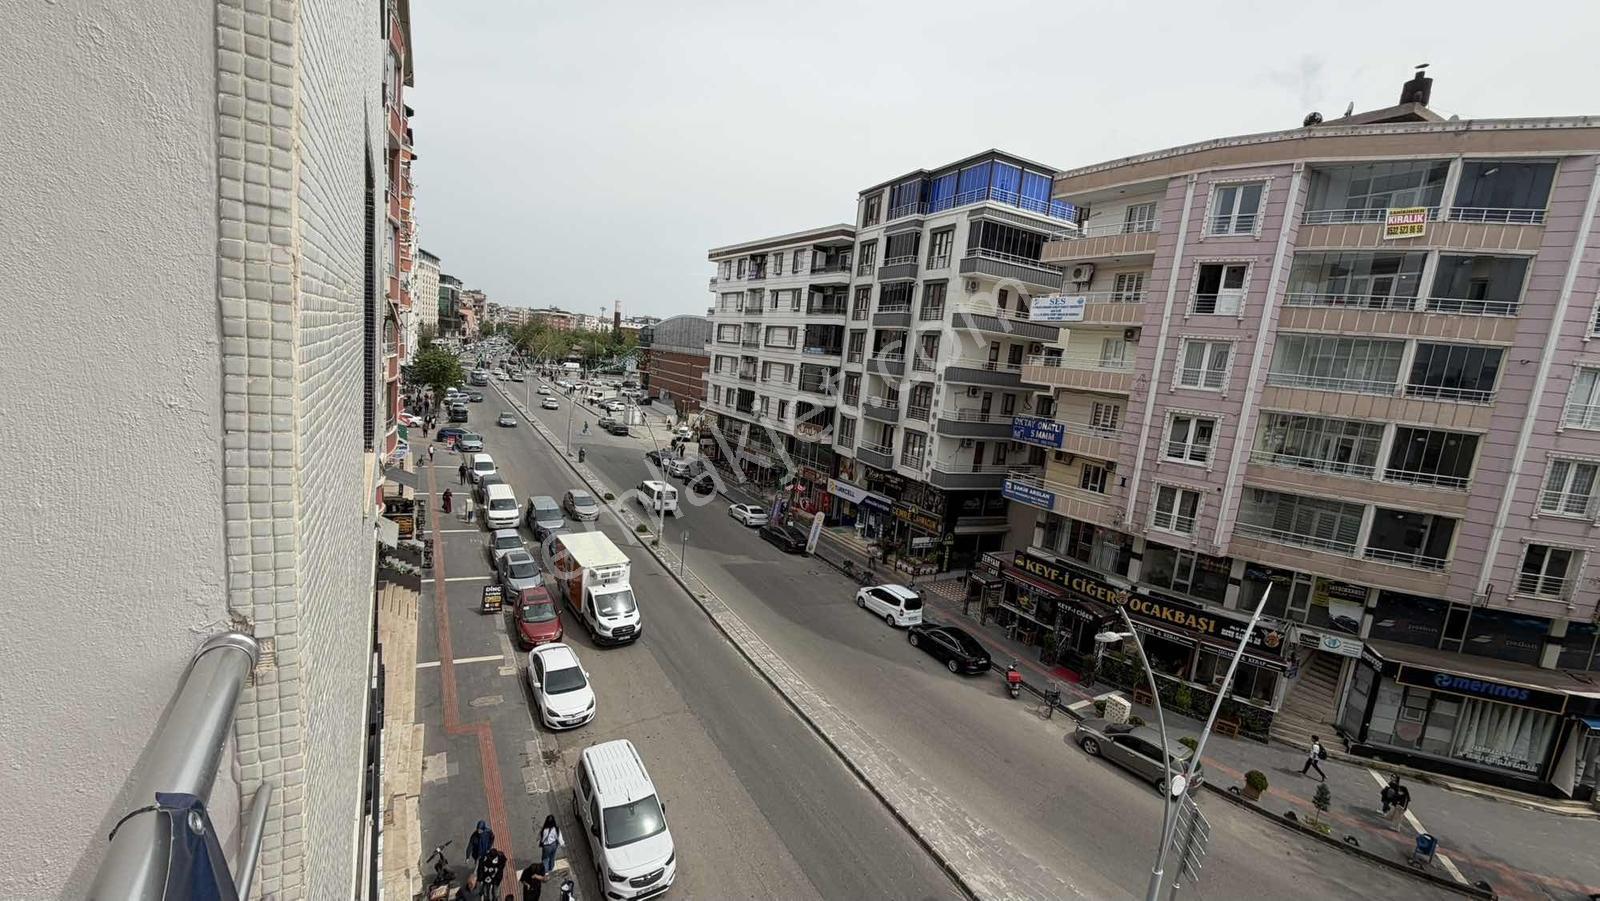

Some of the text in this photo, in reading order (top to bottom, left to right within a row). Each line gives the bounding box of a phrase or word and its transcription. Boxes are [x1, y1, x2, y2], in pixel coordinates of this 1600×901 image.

[1049, 297, 1066, 305] SES
[1014, 417, 1036, 428] OKTAY
[1071, 578, 1117, 605] CİĞER
[1129, 598, 1217, 634] OCAKBAŞI
[1452, 677, 1531, 701] merinos
